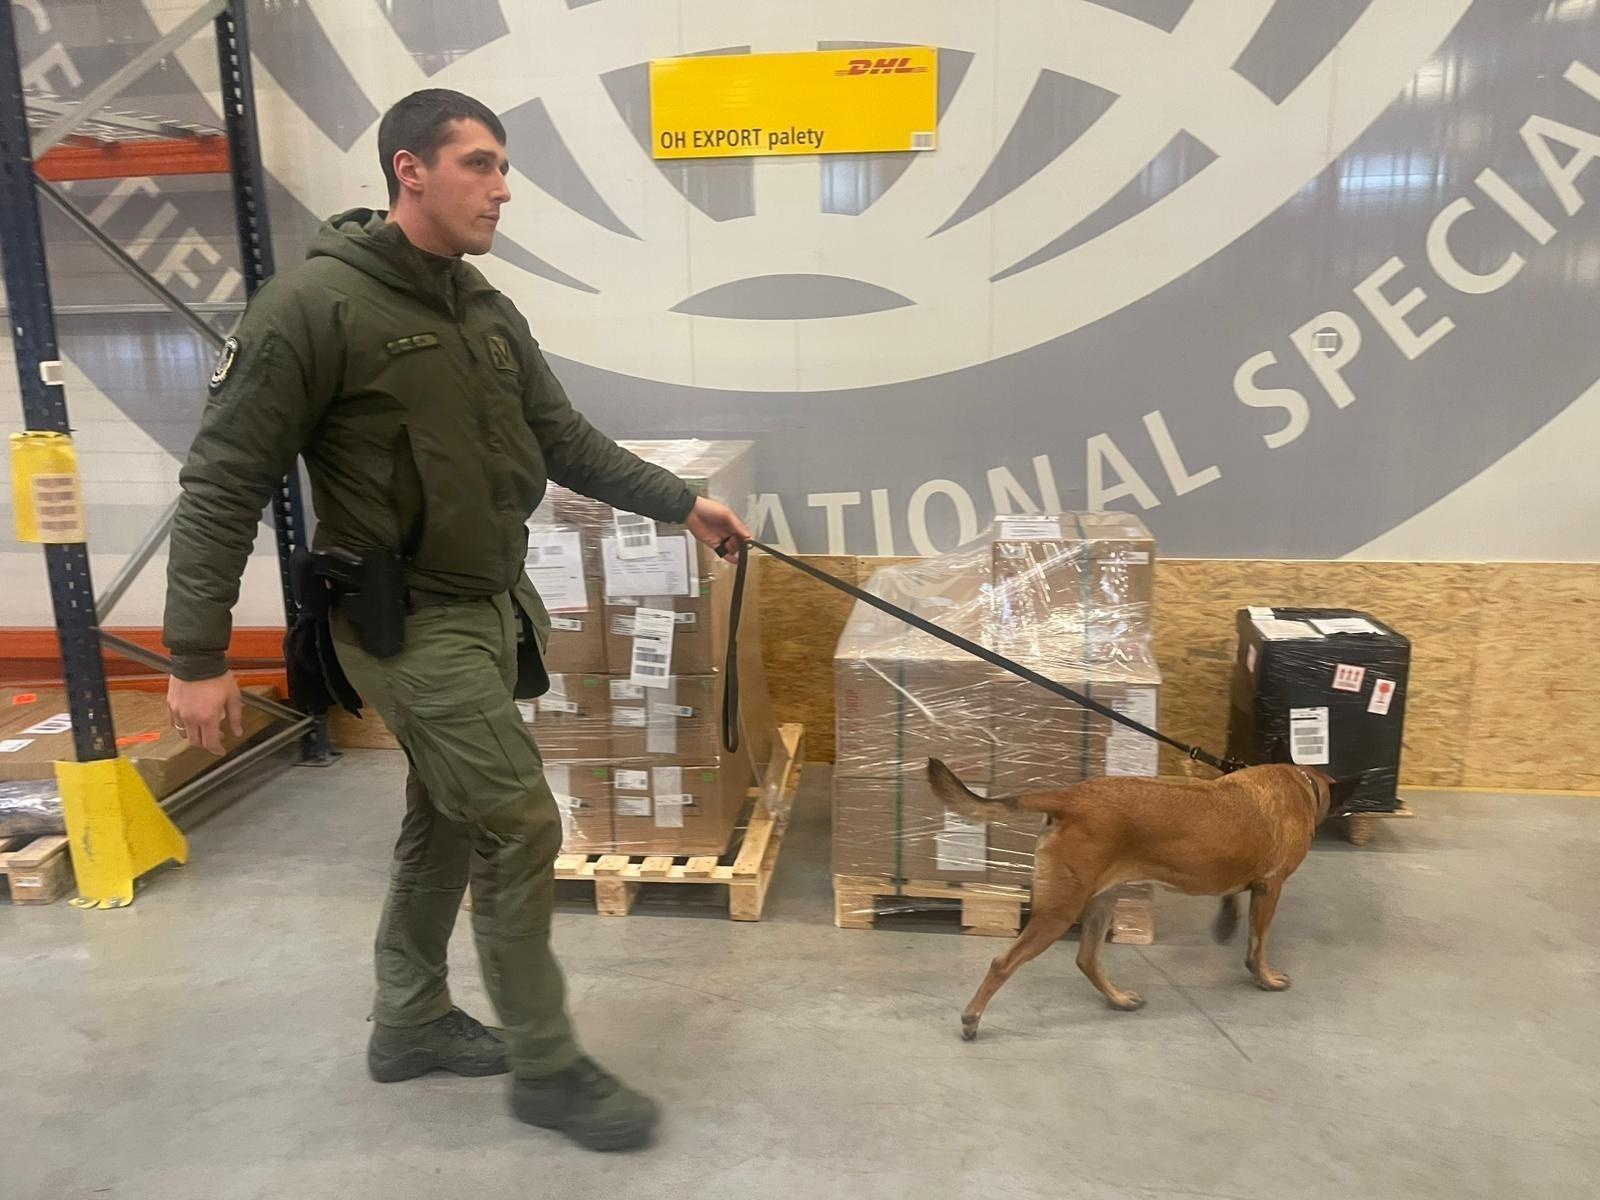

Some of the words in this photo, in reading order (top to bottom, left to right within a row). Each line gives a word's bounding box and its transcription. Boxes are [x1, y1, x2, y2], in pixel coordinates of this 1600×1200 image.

[847, 58, 915, 76] DHL
[660, 131, 686, 149] OH
[693, 128, 763, 149] EXPORT
[768, 126, 824, 150] palety
[746, 410, 1222, 558] ATIONAL
